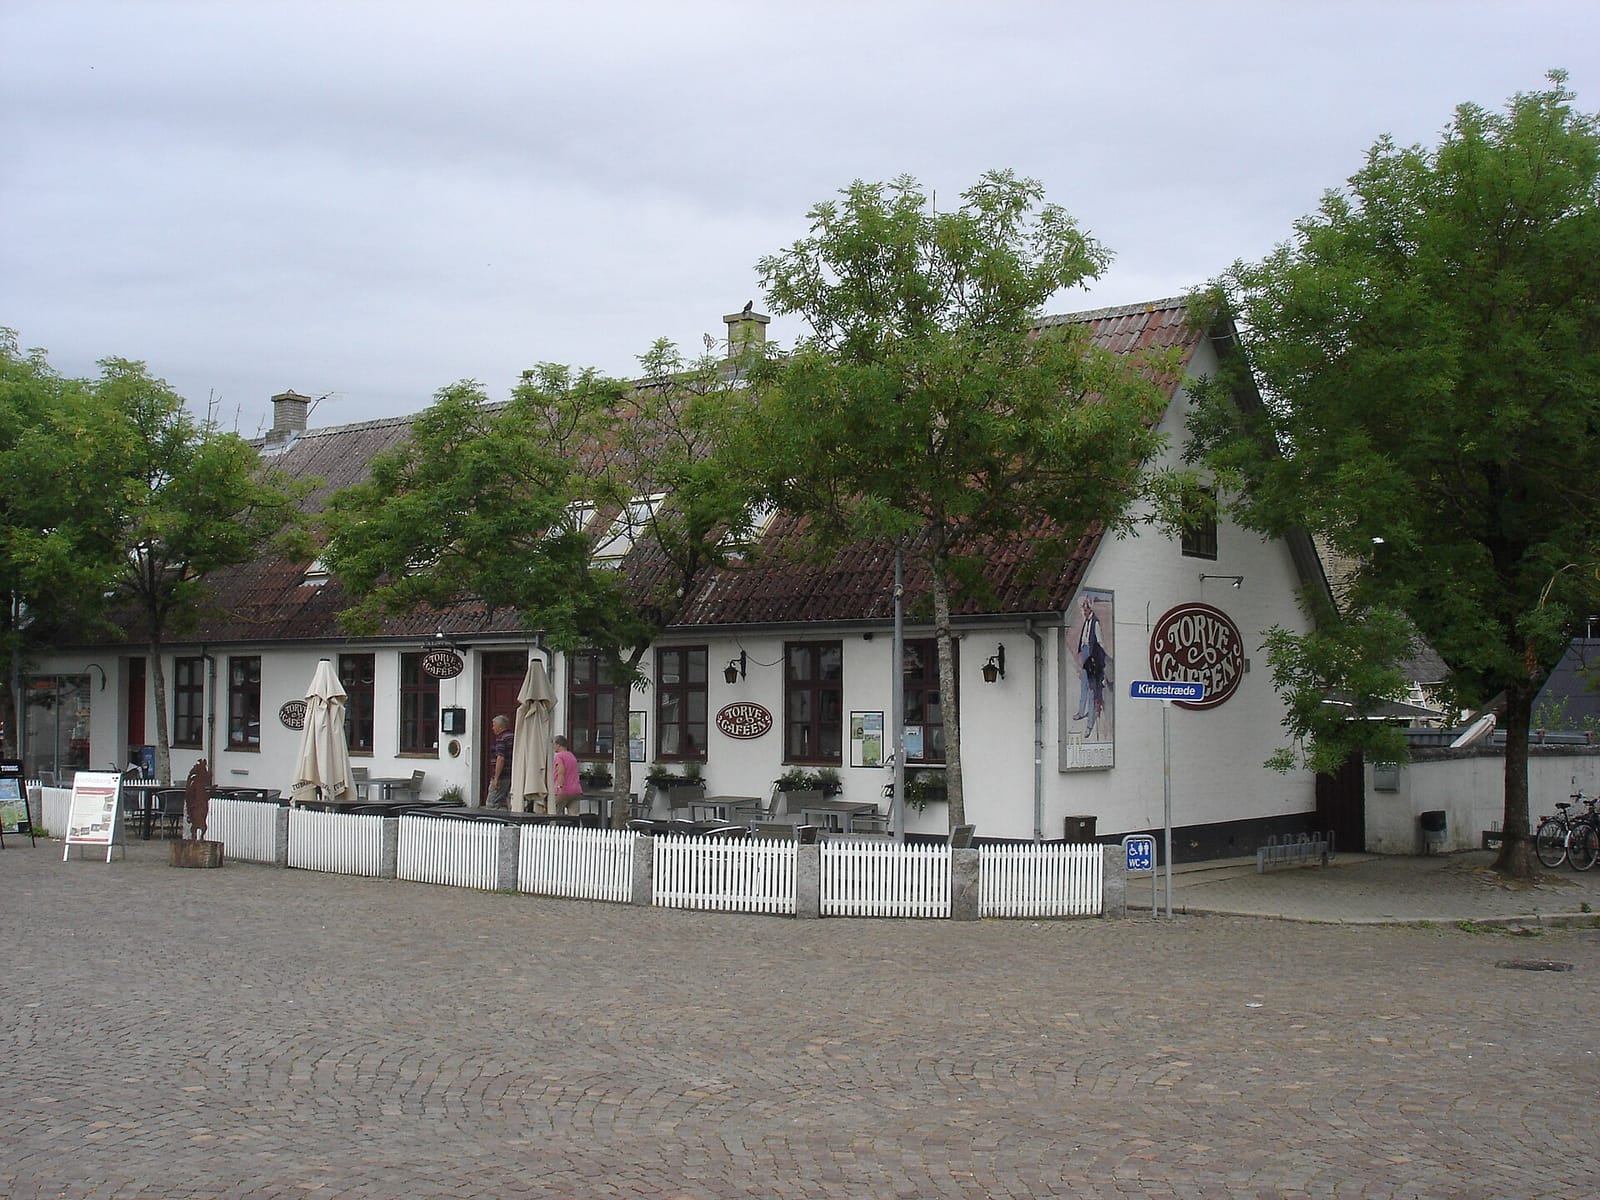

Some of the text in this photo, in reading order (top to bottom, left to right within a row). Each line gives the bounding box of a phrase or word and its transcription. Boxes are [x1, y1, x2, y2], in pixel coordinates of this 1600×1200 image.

[1168, 614, 1230, 655] TORVE
[1138, 683, 1196, 696] Kirkestræde
[725, 705, 763, 720] TORVE
[1128, 858, 1141, 867] WC
